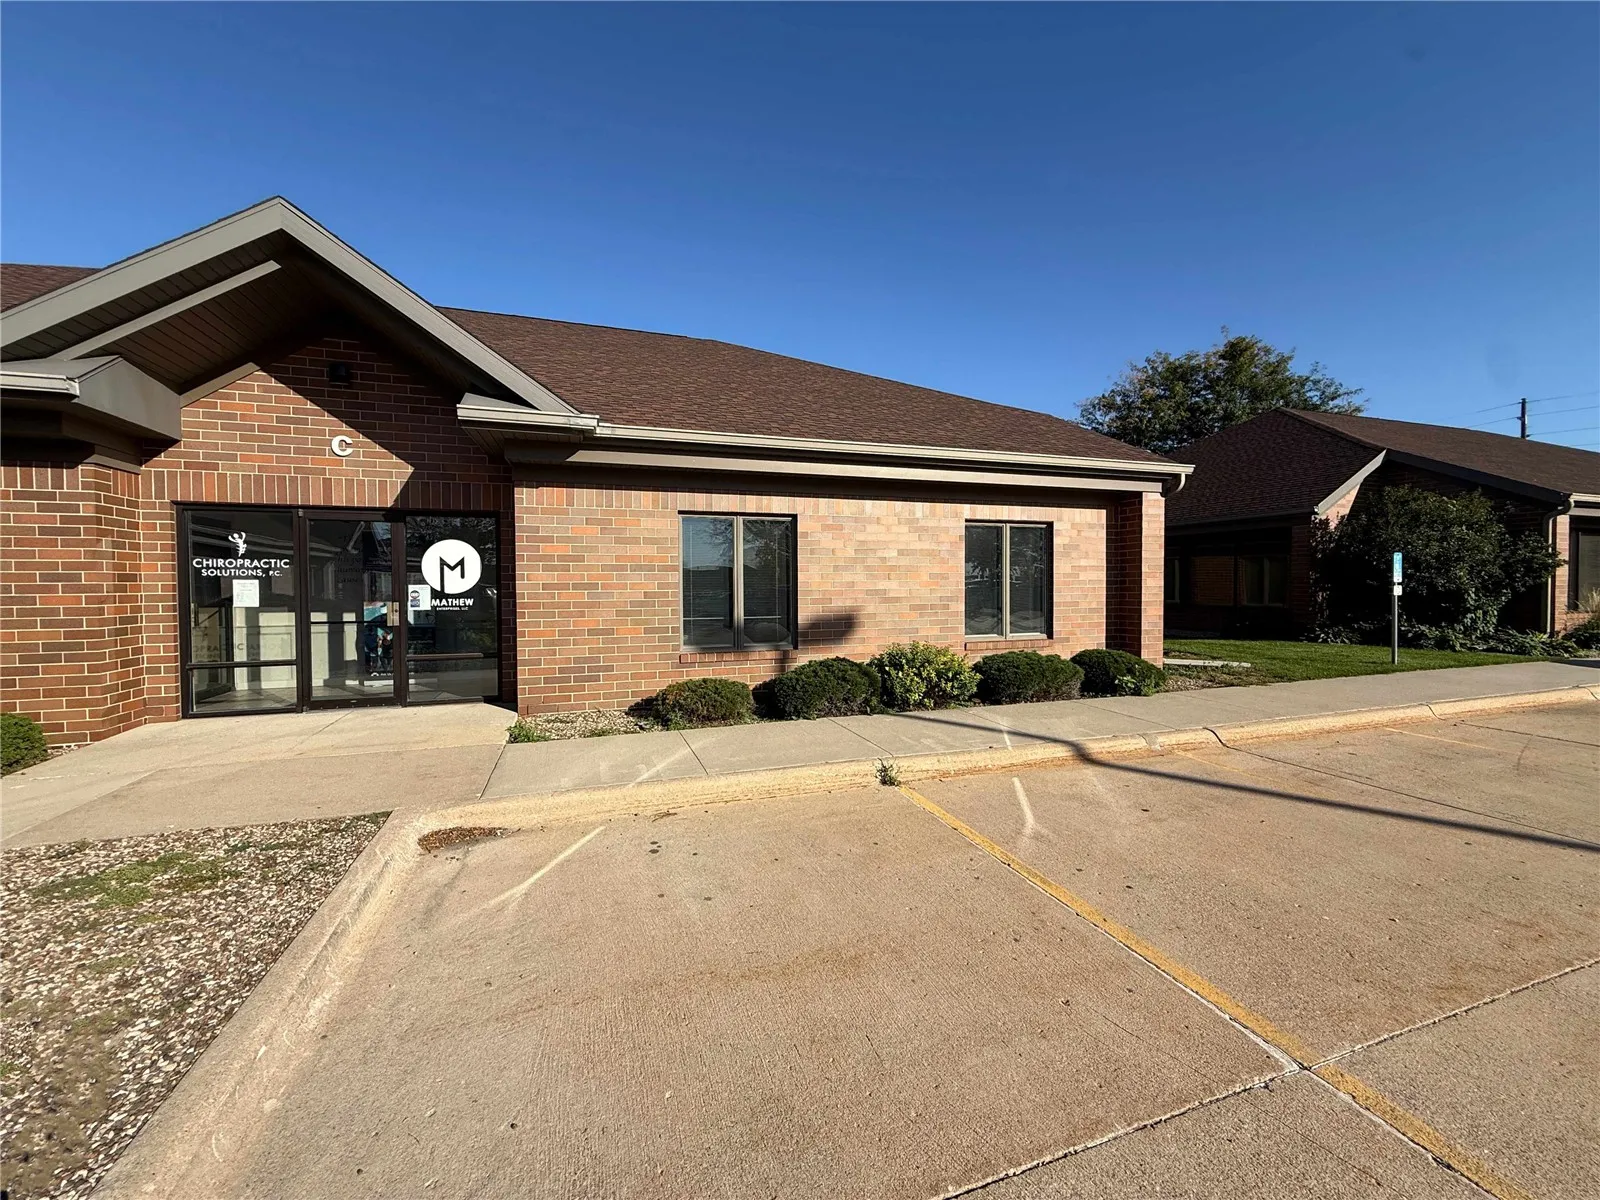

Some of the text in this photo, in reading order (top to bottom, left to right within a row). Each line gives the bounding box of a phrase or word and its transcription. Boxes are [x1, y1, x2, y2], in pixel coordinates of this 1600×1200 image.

[331, 435, 354, 457] C
[192, 558, 290, 568] CHIROPRACTIC
[201, 568, 266, 577] SOLUTIONS,
[439, 556, 465, 592] M
[431, 598, 474, 606] MATHEW
